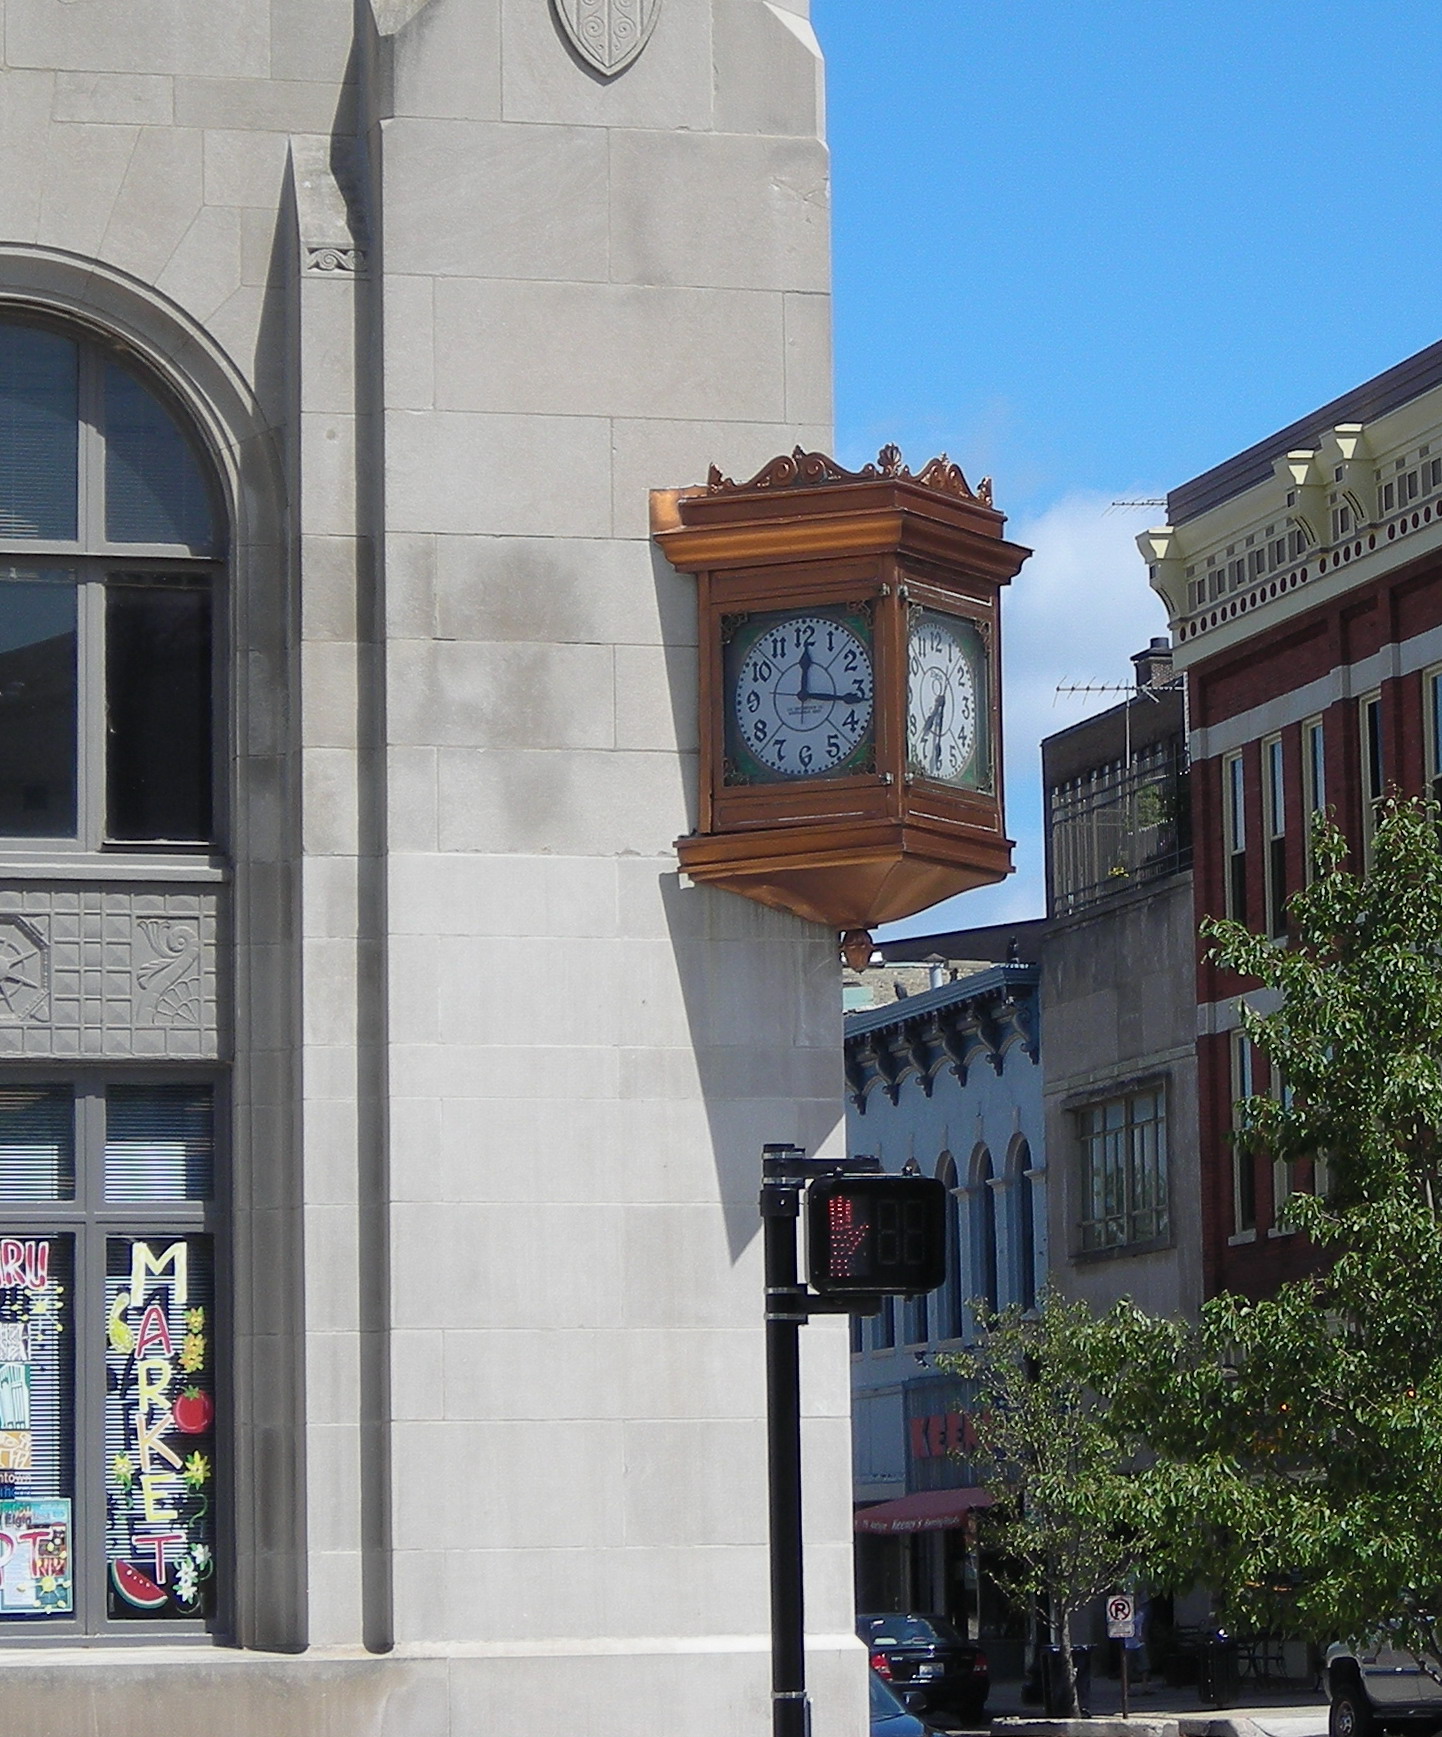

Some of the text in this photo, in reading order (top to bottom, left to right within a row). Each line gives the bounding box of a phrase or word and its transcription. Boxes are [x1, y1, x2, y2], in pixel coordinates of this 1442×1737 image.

[771, 637, 787, 659] 11
[794, 624, 816, 649] 12
[826, 630, 834, 652] 1
[918, 636, 926, 658] 11
[930, 632, 943, 653] 12
[843, 648, 858, 673] 2
[948, 643, 952, 663] 1
[752, 660, 772, 683] 10
[911, 656, 919, 677] 0
[957, 665, 965, 687] 2
[746, 690, 760, 713] 9
[851, 679, 866, 701] 3
[961, 696, 971, 720] 3
[754, 719, 767, 743] 8
[842, 709, 859, 733] 4
[909, 714, 917, 736] 8
[826, 734, 841, 758] 5
[957, 725, 967, 748] 4
[772, 739, 787, 762] 7
[799, 745, 813, 768] 6
[920, 738, 928, 760] 7
[949, 745, 958, 768] 5
[0, 1239, 49, 1291] RU
[131, 1241, 188, 1585] MARKET
